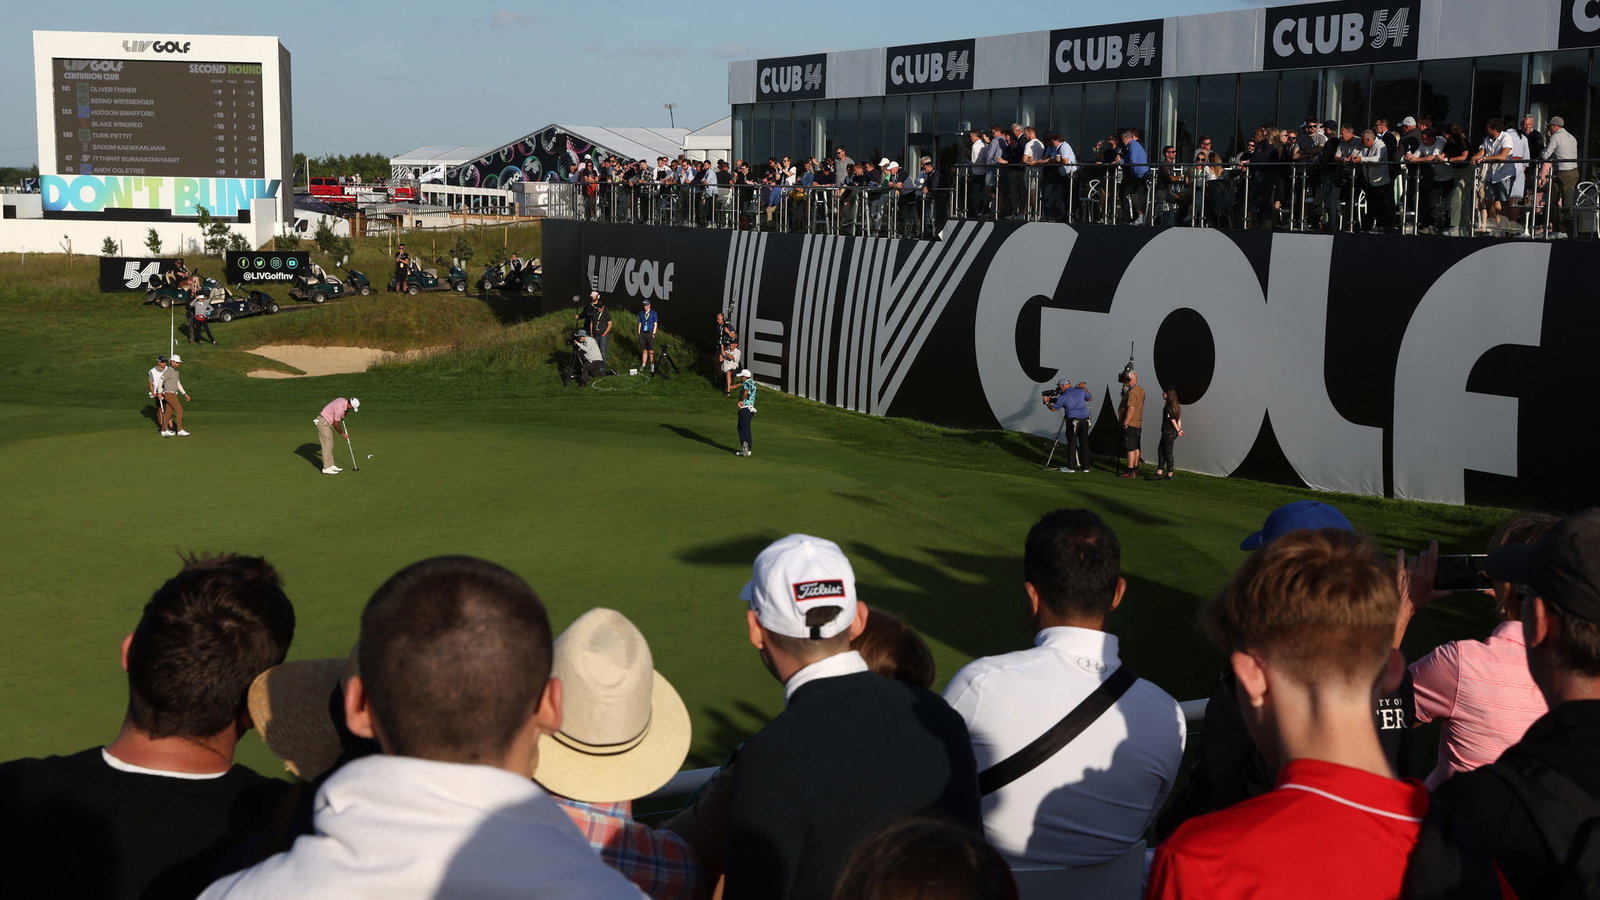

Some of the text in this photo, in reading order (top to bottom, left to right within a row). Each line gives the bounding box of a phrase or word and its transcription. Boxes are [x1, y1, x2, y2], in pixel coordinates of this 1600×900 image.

[152, 41, 190, 54] GOLF
[1272, 6, 1410, 57] CLUB 54
[90, 60, 124, 72] GOLF
[890, 49, 969, 85] CLUB 54
[1055, 31, 1156, 73] CLUB 54
[189, 64, 262, 74] SECOND ROUND
[760, 62, 822, 94] CLUB 54
[42, 174, 281, 216] DON'T BLINK
[123, 261, 162, 289] 54
[588, 254, 674, 300] LIV GOLF
[722, 220, 1552, 506] LIV GOLF
[797, 582, 842, 600] Titleist
[1376, 708, 1408, 730] ER
